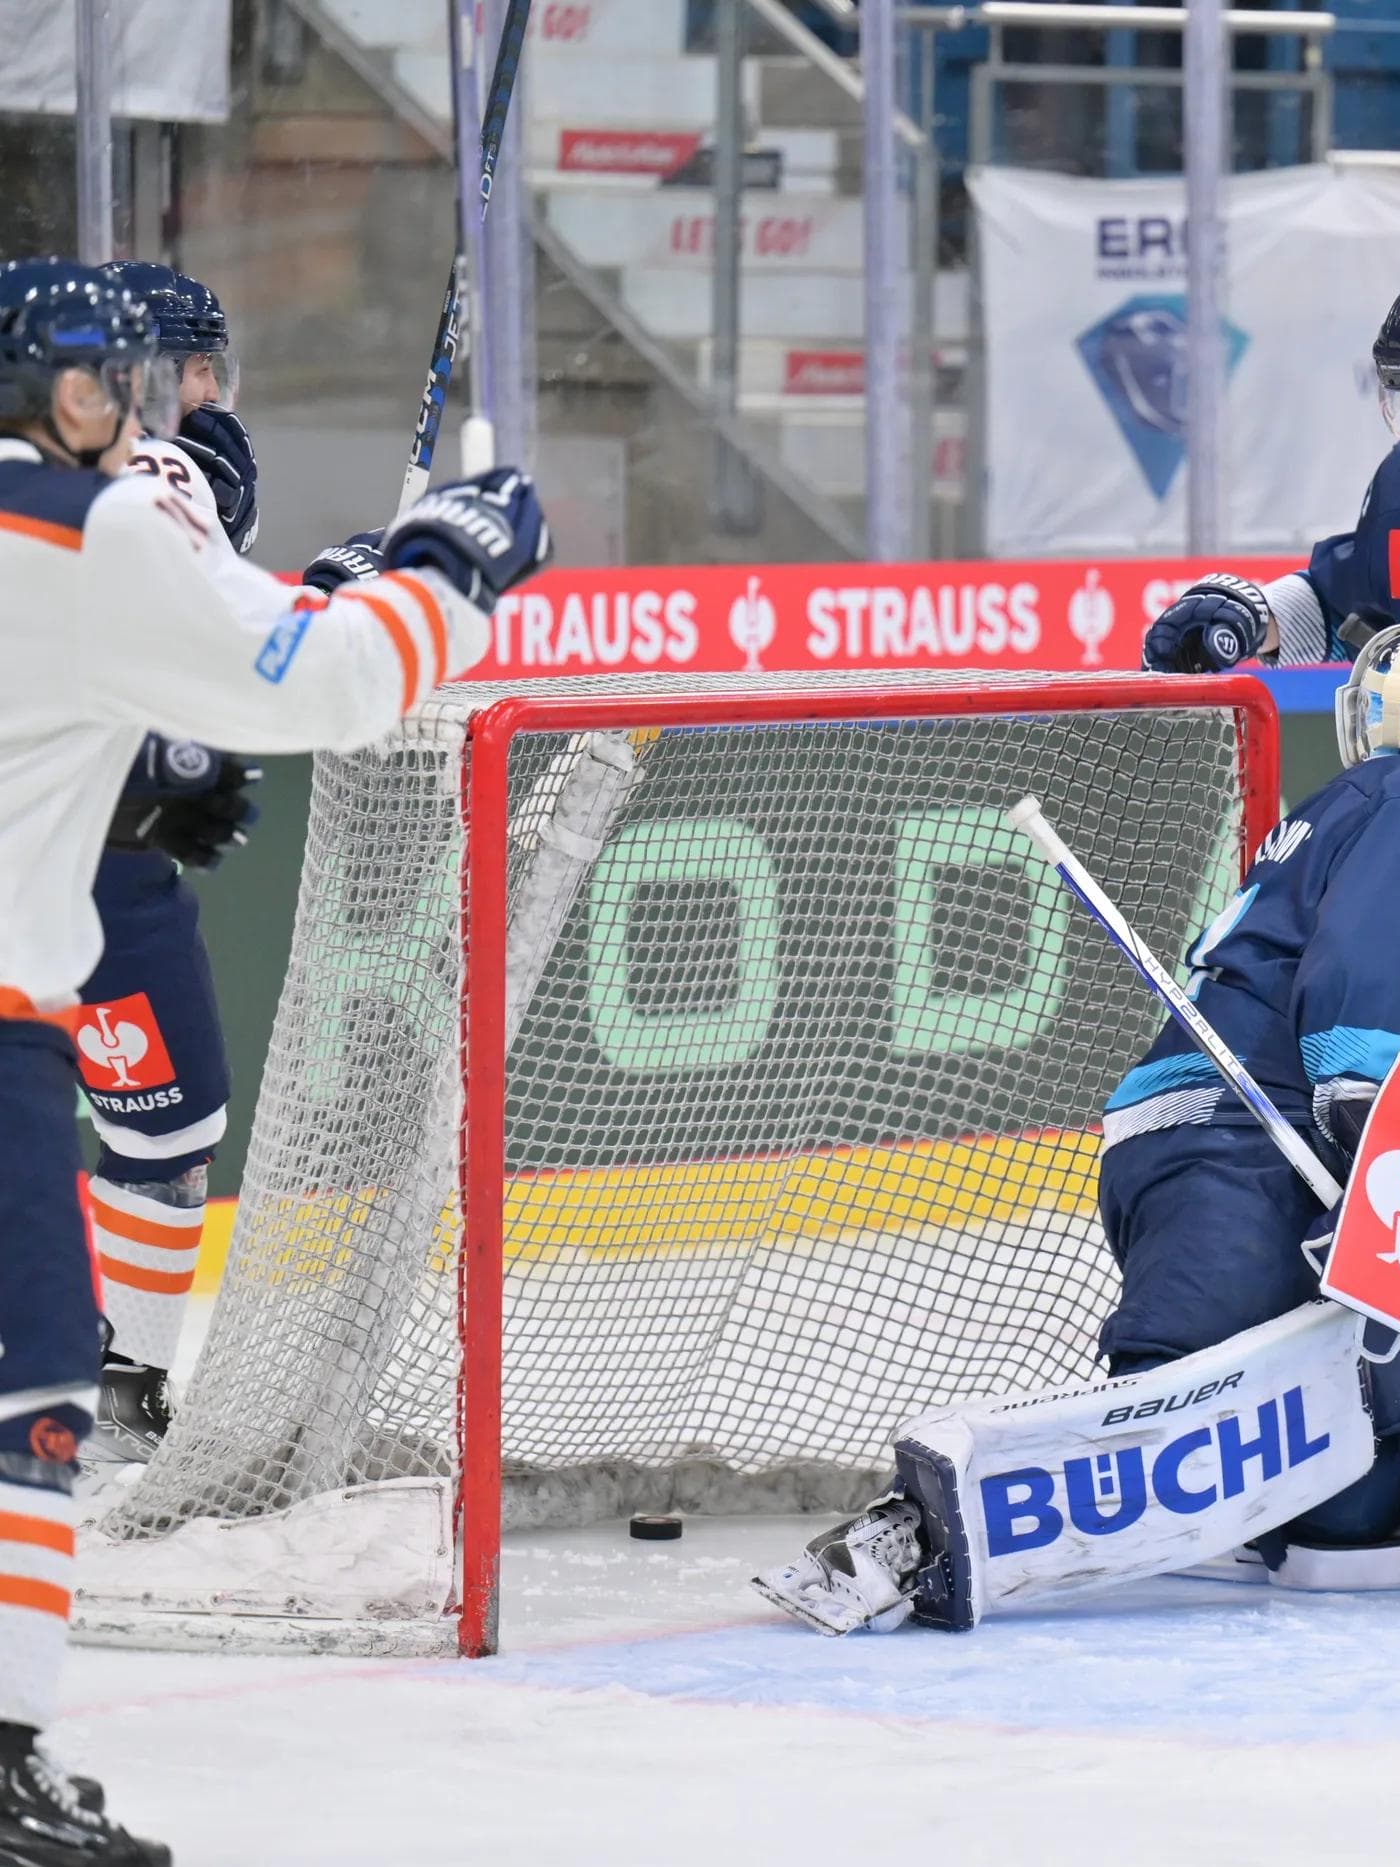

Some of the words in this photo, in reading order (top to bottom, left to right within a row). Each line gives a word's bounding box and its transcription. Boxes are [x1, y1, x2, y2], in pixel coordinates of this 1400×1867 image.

[494, 586, 698, 666] TRAUSS
[806, 582, 1041, 661] STRAUSS
[89, 1086, 184, 1113] STRAUSS
[1100, 1370, 1246, 1428] BAUER
[979, 1384, 1331, 1559] BÜCHL
